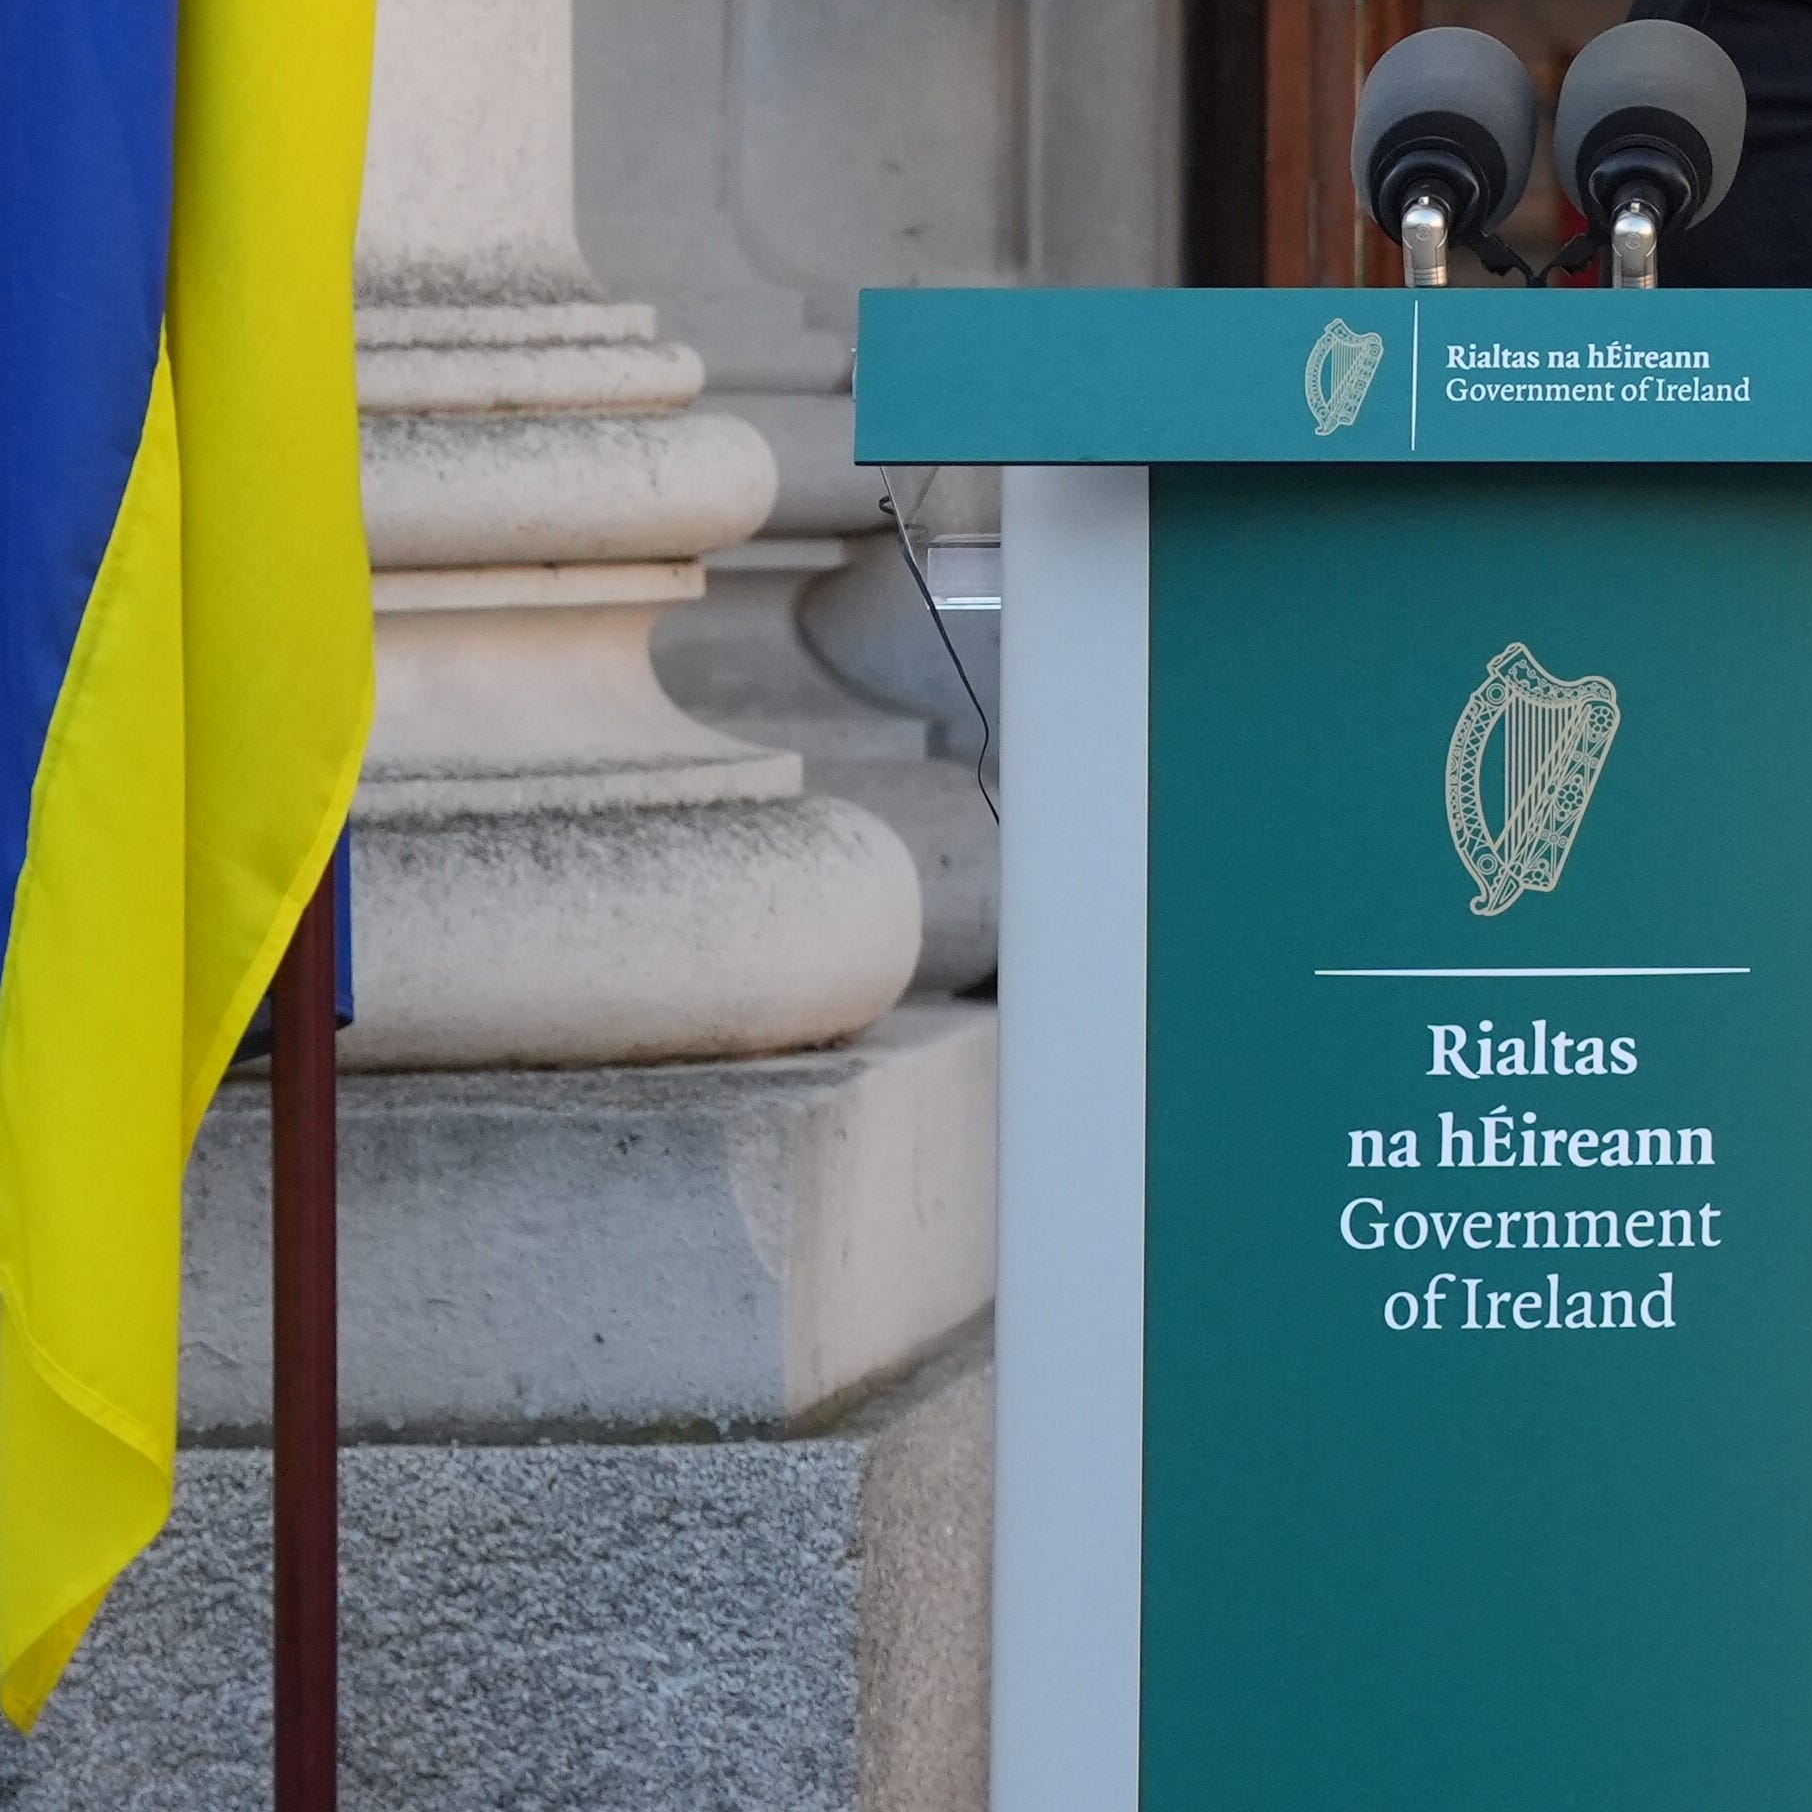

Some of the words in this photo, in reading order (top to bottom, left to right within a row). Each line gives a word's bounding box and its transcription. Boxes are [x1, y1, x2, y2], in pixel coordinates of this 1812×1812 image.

[1446, 343, 1541, 370] Rialtas
[1547, 351, 1581, 369] na
[1587, 340, 1710, 369] hÉireann
[1445, 377, 1616, 402] Government
[1620, 376, 1655, 402] of
[1655, 376, 1751, 402] Ireland
[1425, 1019, 1639, 1080] Rialtas
[1347, 1129, 1421, 1168] na
[1437, 1104, 1716, 1167] hÉireann
[1340, 1197, 1722, 1250] Government
[1384, 1273, 1457, 1330] of
[1460, 1271, 1677, 1330] Ireland
